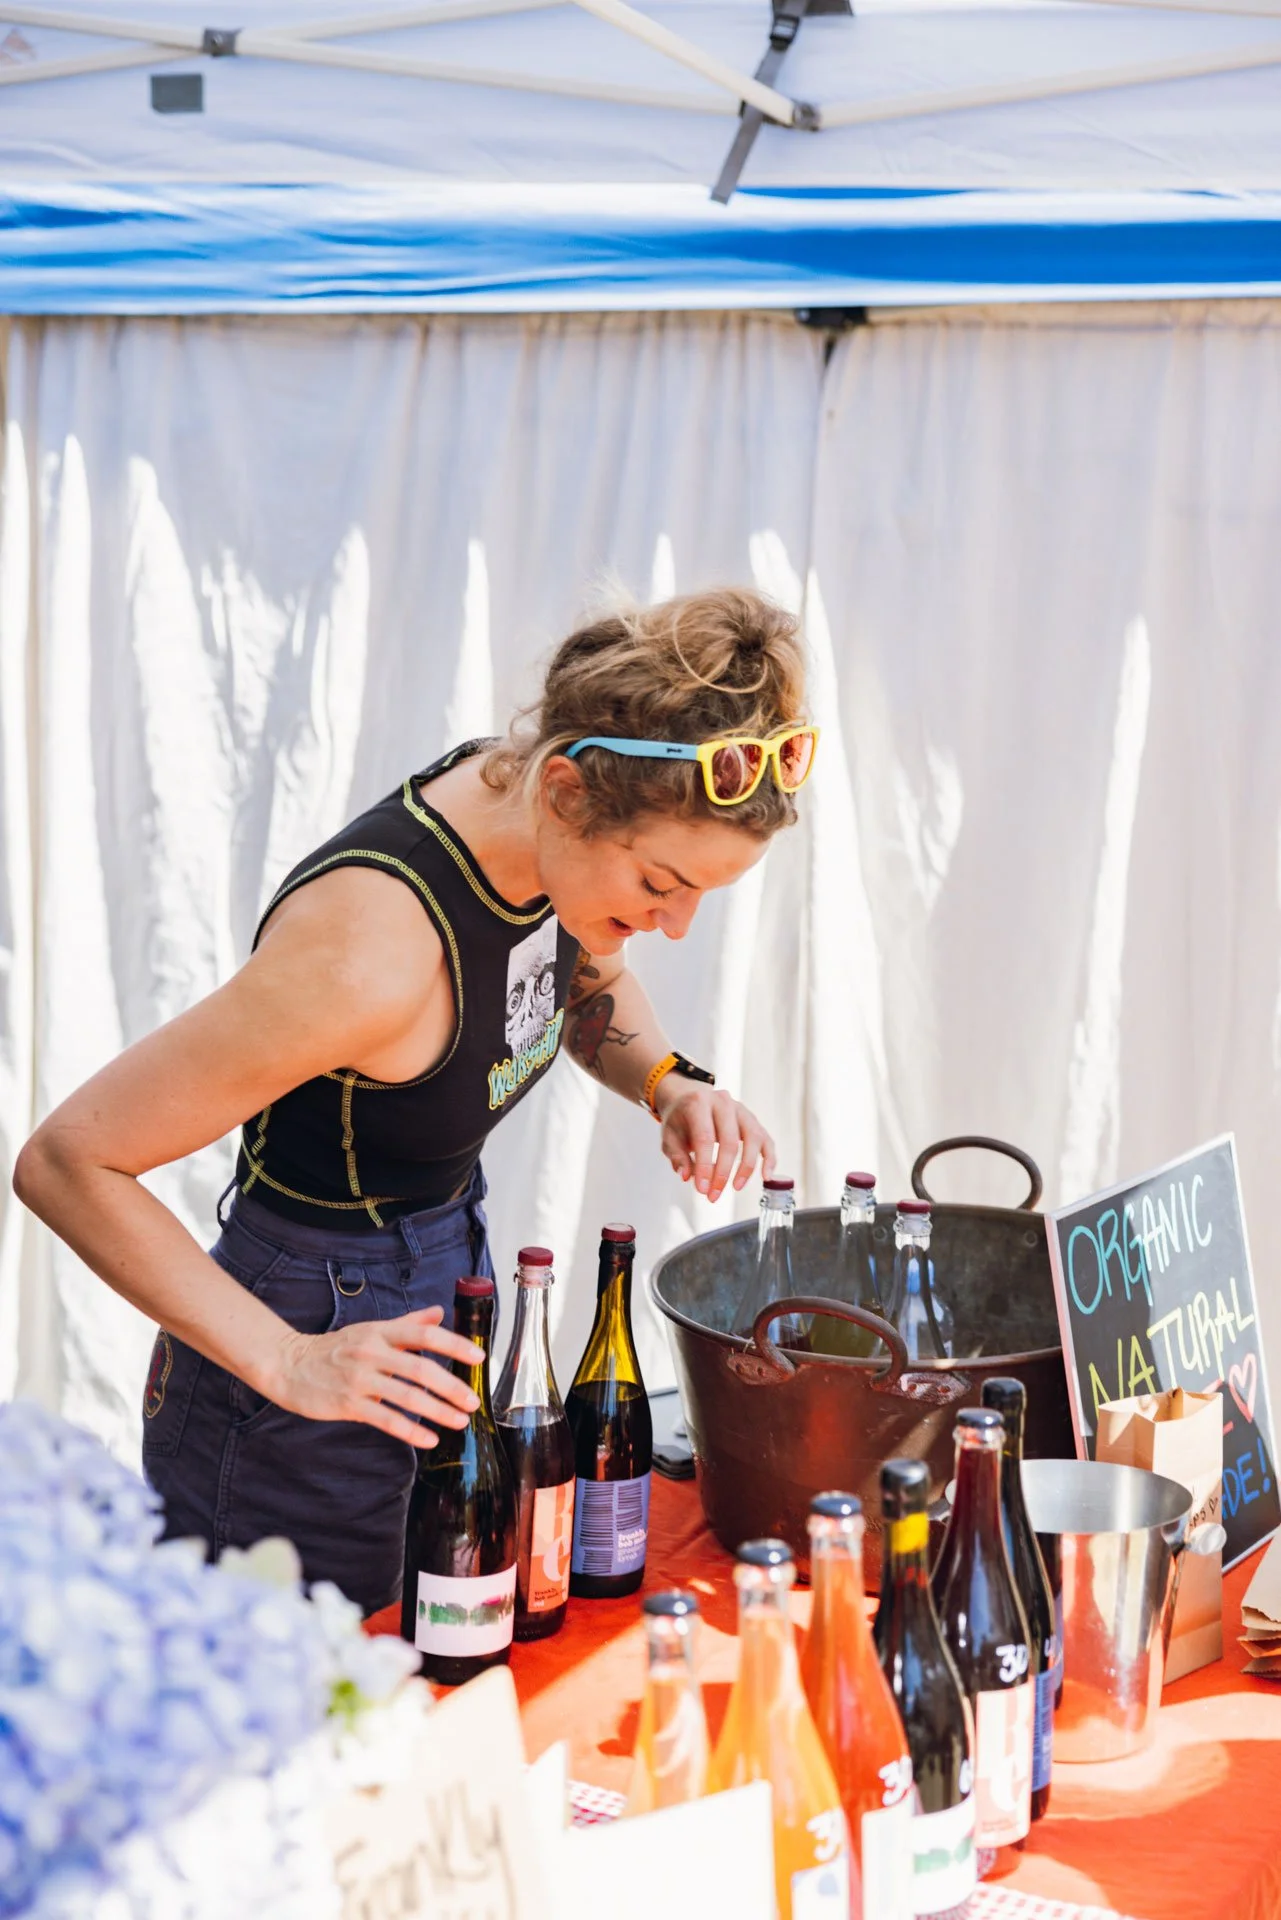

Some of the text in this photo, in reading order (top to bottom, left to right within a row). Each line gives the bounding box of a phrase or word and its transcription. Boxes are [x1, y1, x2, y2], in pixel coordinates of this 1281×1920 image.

[1067, 1174, 1213, 1315] ORGANIC
[1088, 1277, 1255, 1421] NATURAL
[996, 1644, 1029, 1683] 30
